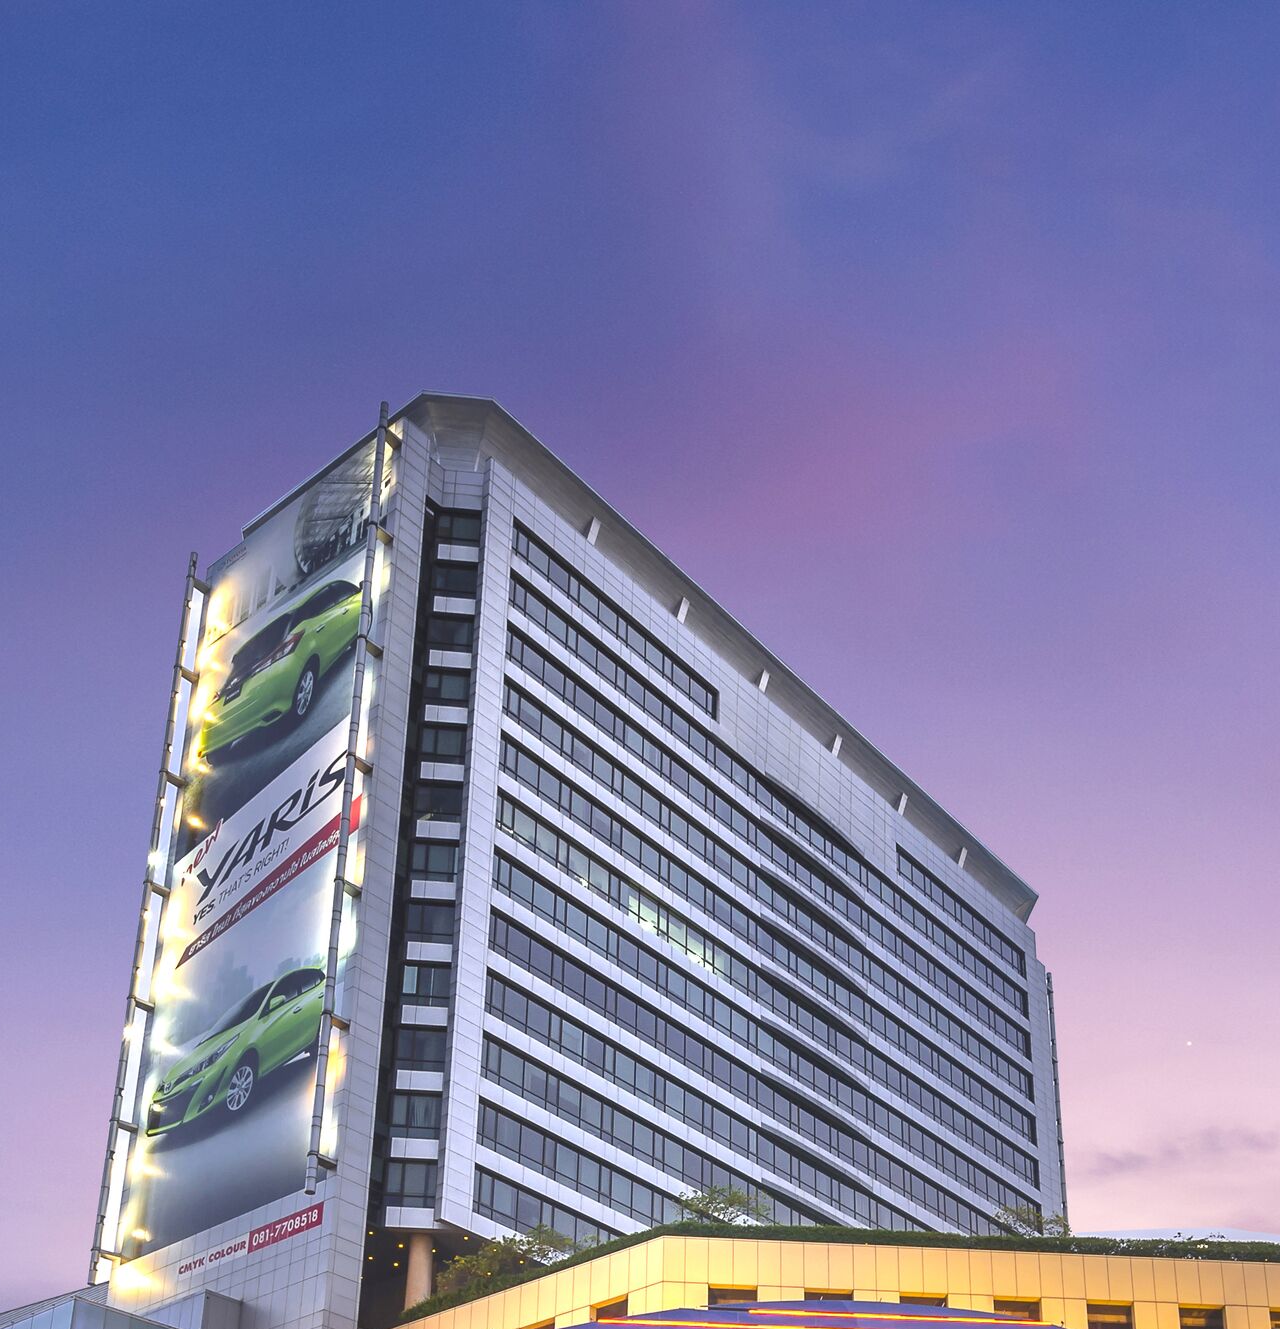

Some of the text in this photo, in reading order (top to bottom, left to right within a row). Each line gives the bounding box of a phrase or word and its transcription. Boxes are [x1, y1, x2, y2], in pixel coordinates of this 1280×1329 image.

[252, 837, 290, 876] RIGHT!
[178, 1209, 318, 1275] CMYK COLOUR 081-7708518
